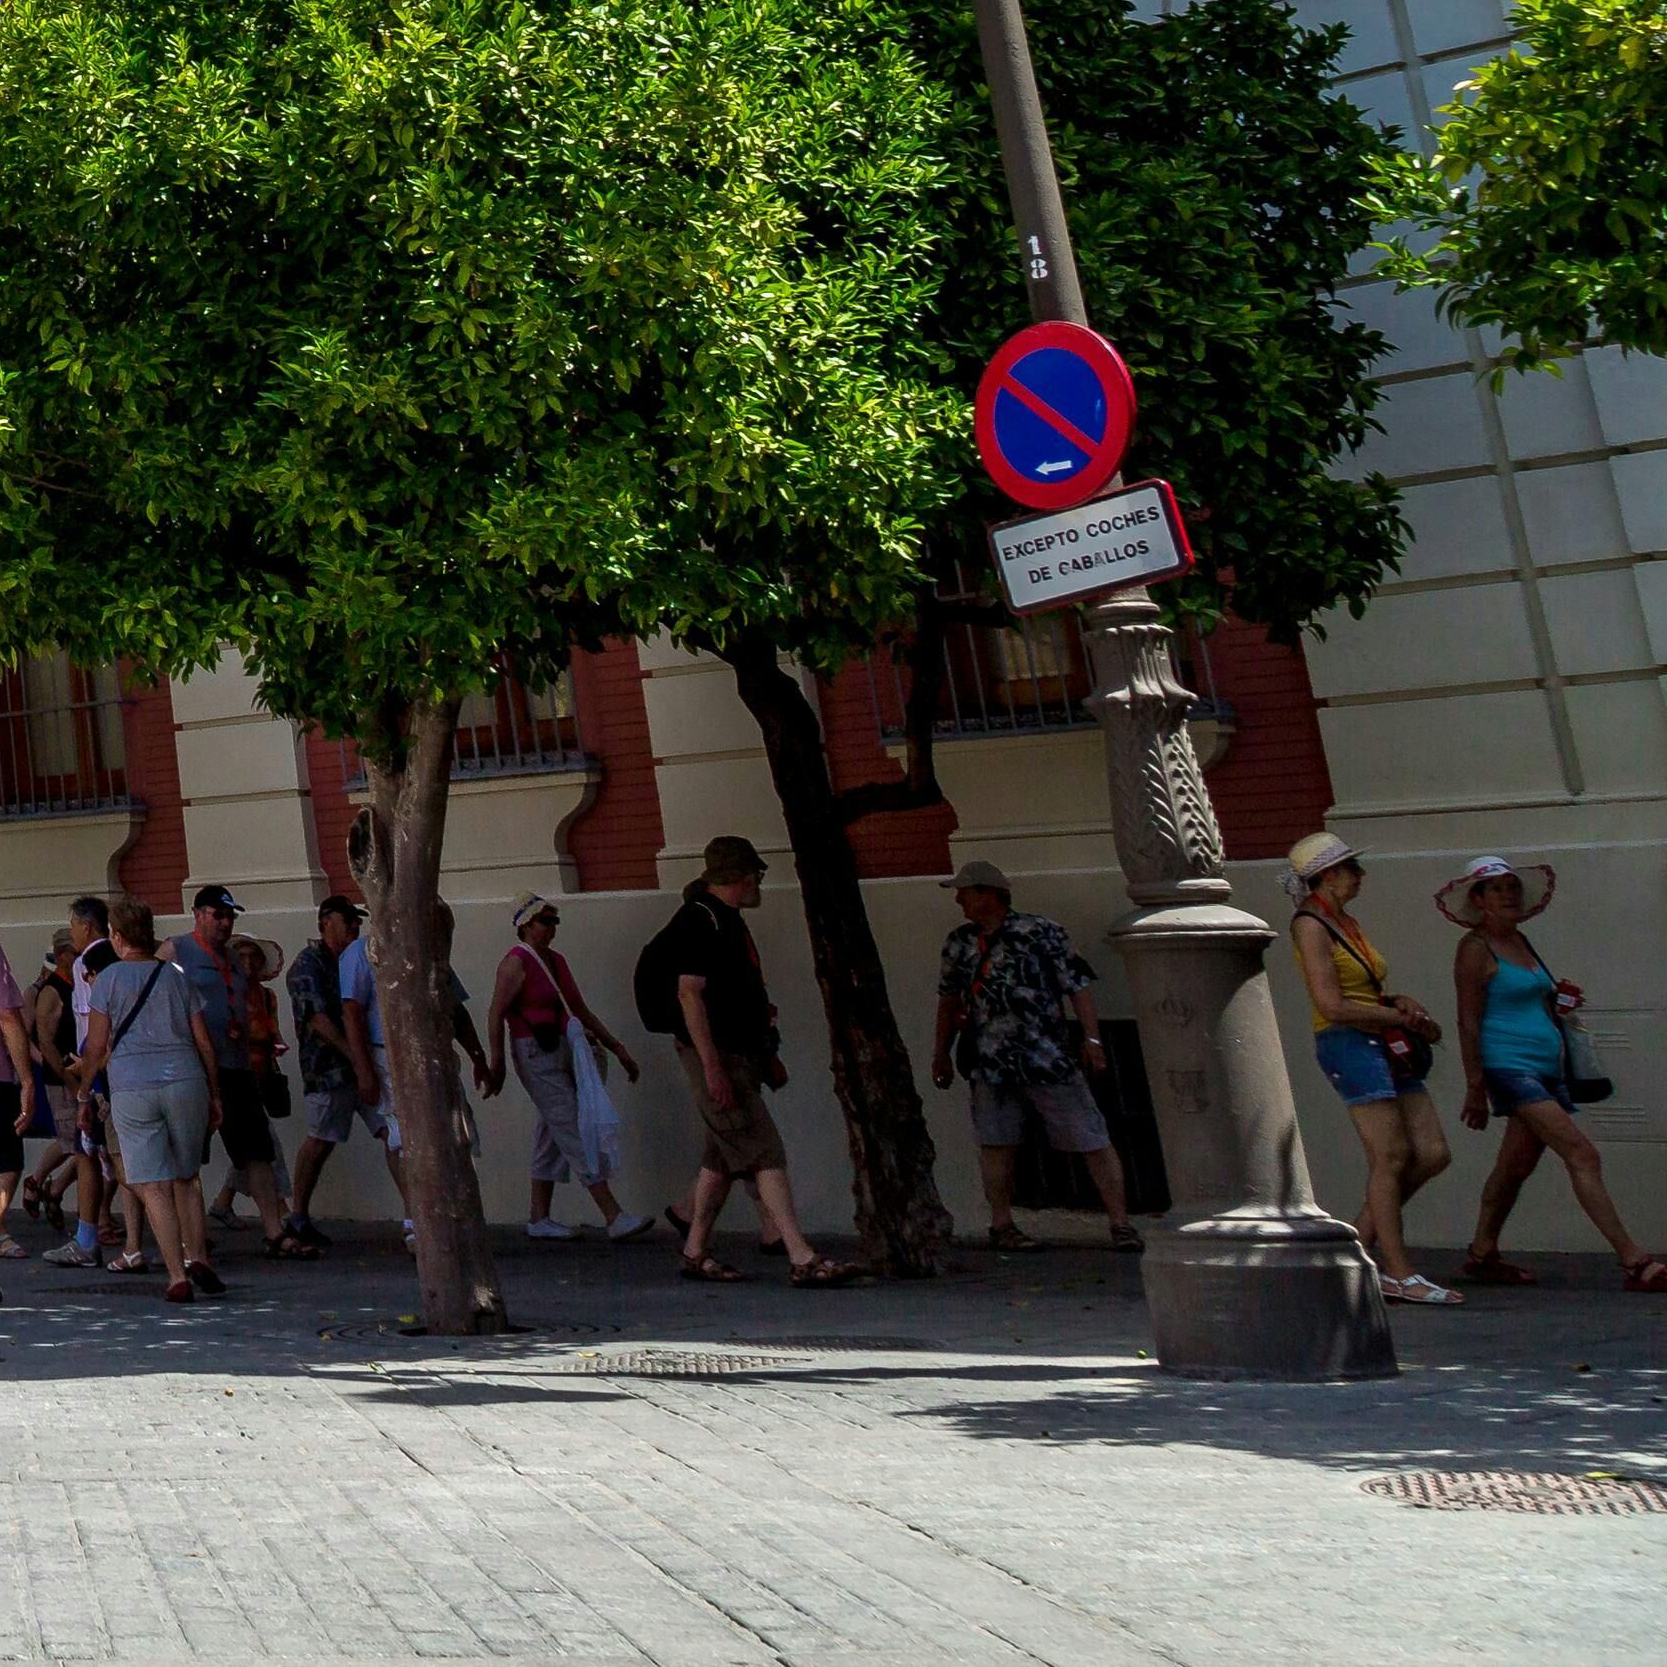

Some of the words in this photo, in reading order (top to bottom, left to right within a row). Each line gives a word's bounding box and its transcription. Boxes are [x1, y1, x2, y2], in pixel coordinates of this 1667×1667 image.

[1002, 528, 1079, 561] EXCEPTO
[1085, 506, 1160, 538] COCHES
[1028, 565, 1053, 584] DE
[1058, 539, 1150, 576] CABALLOS
